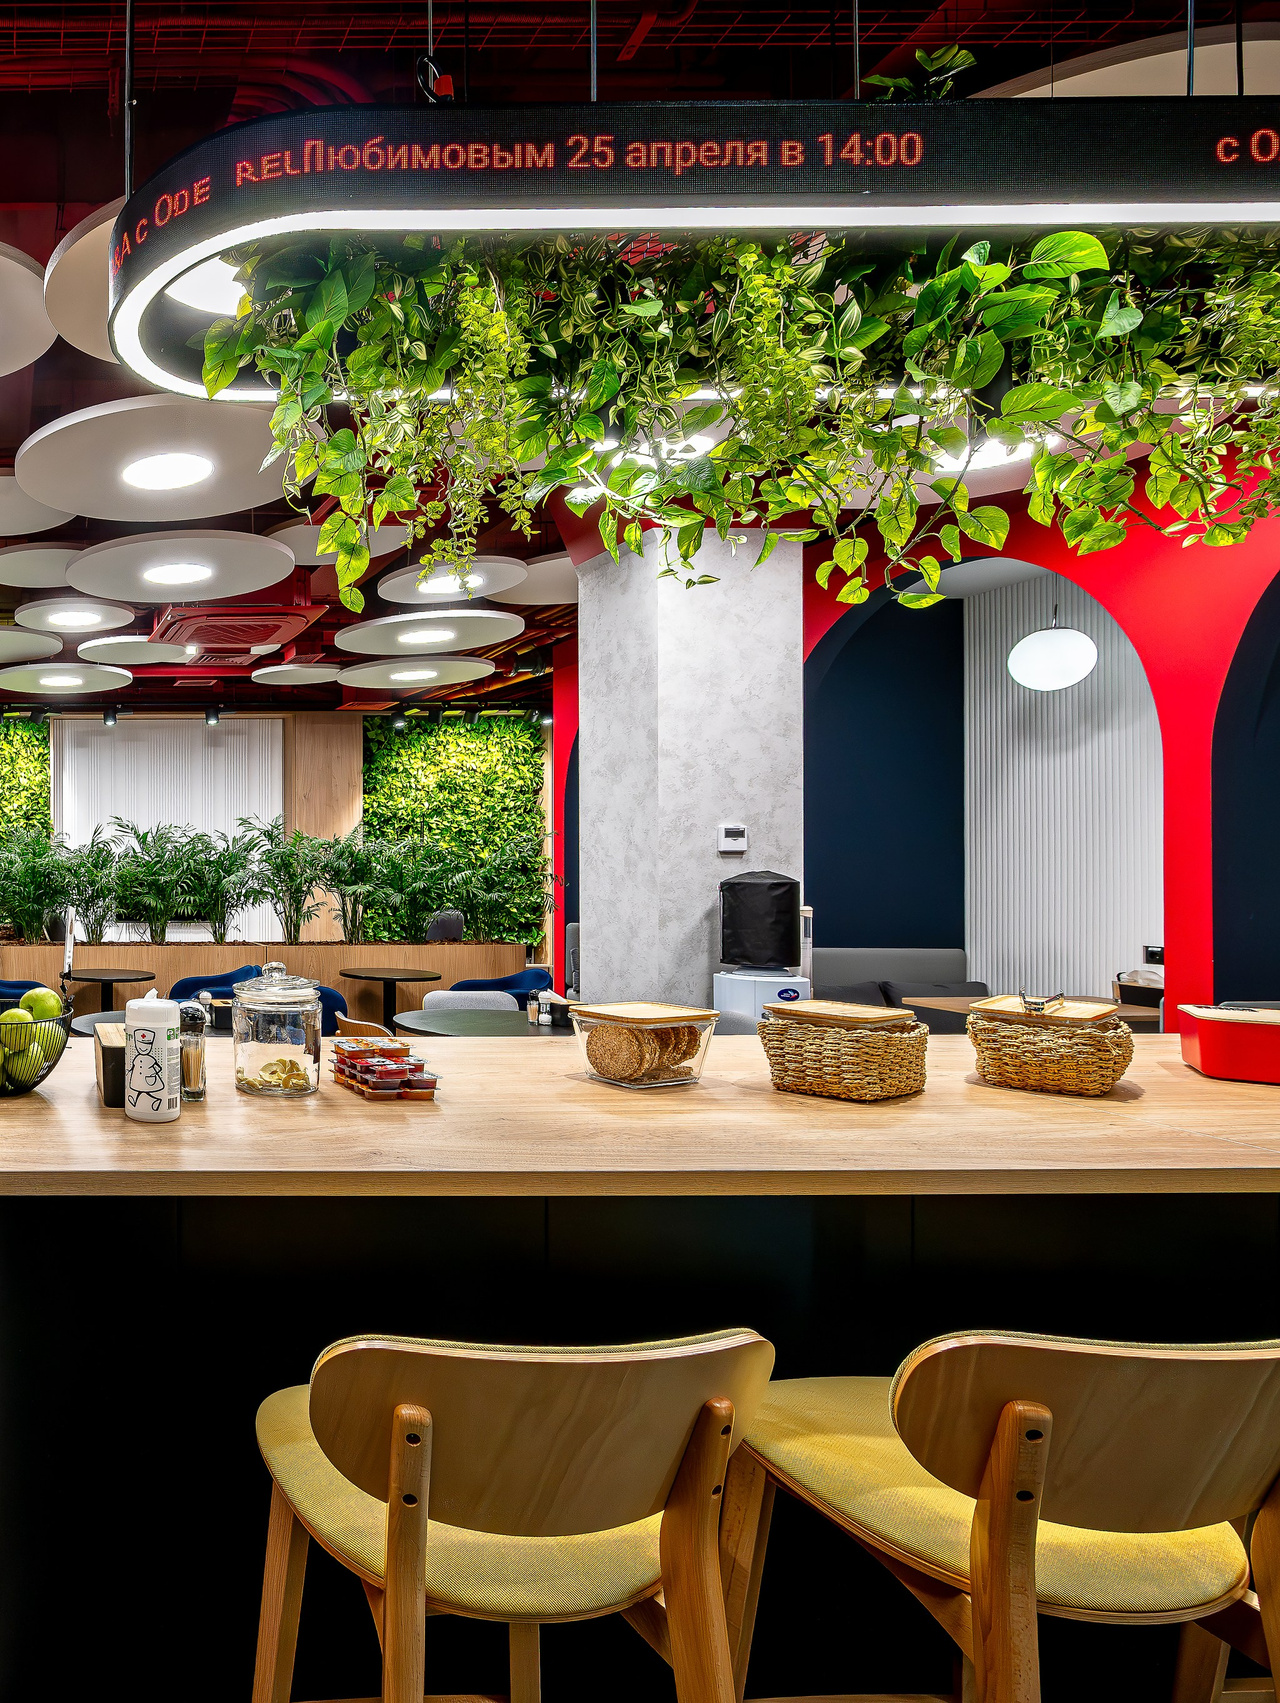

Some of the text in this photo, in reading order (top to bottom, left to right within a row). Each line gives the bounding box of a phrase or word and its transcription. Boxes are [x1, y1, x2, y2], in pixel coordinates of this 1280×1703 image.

[566, 134, 614, 168] 25
[626, 139, 768, 176] апреля
[781, 139, 806, 167] в
[818, 131, 923, 167] 14:00
